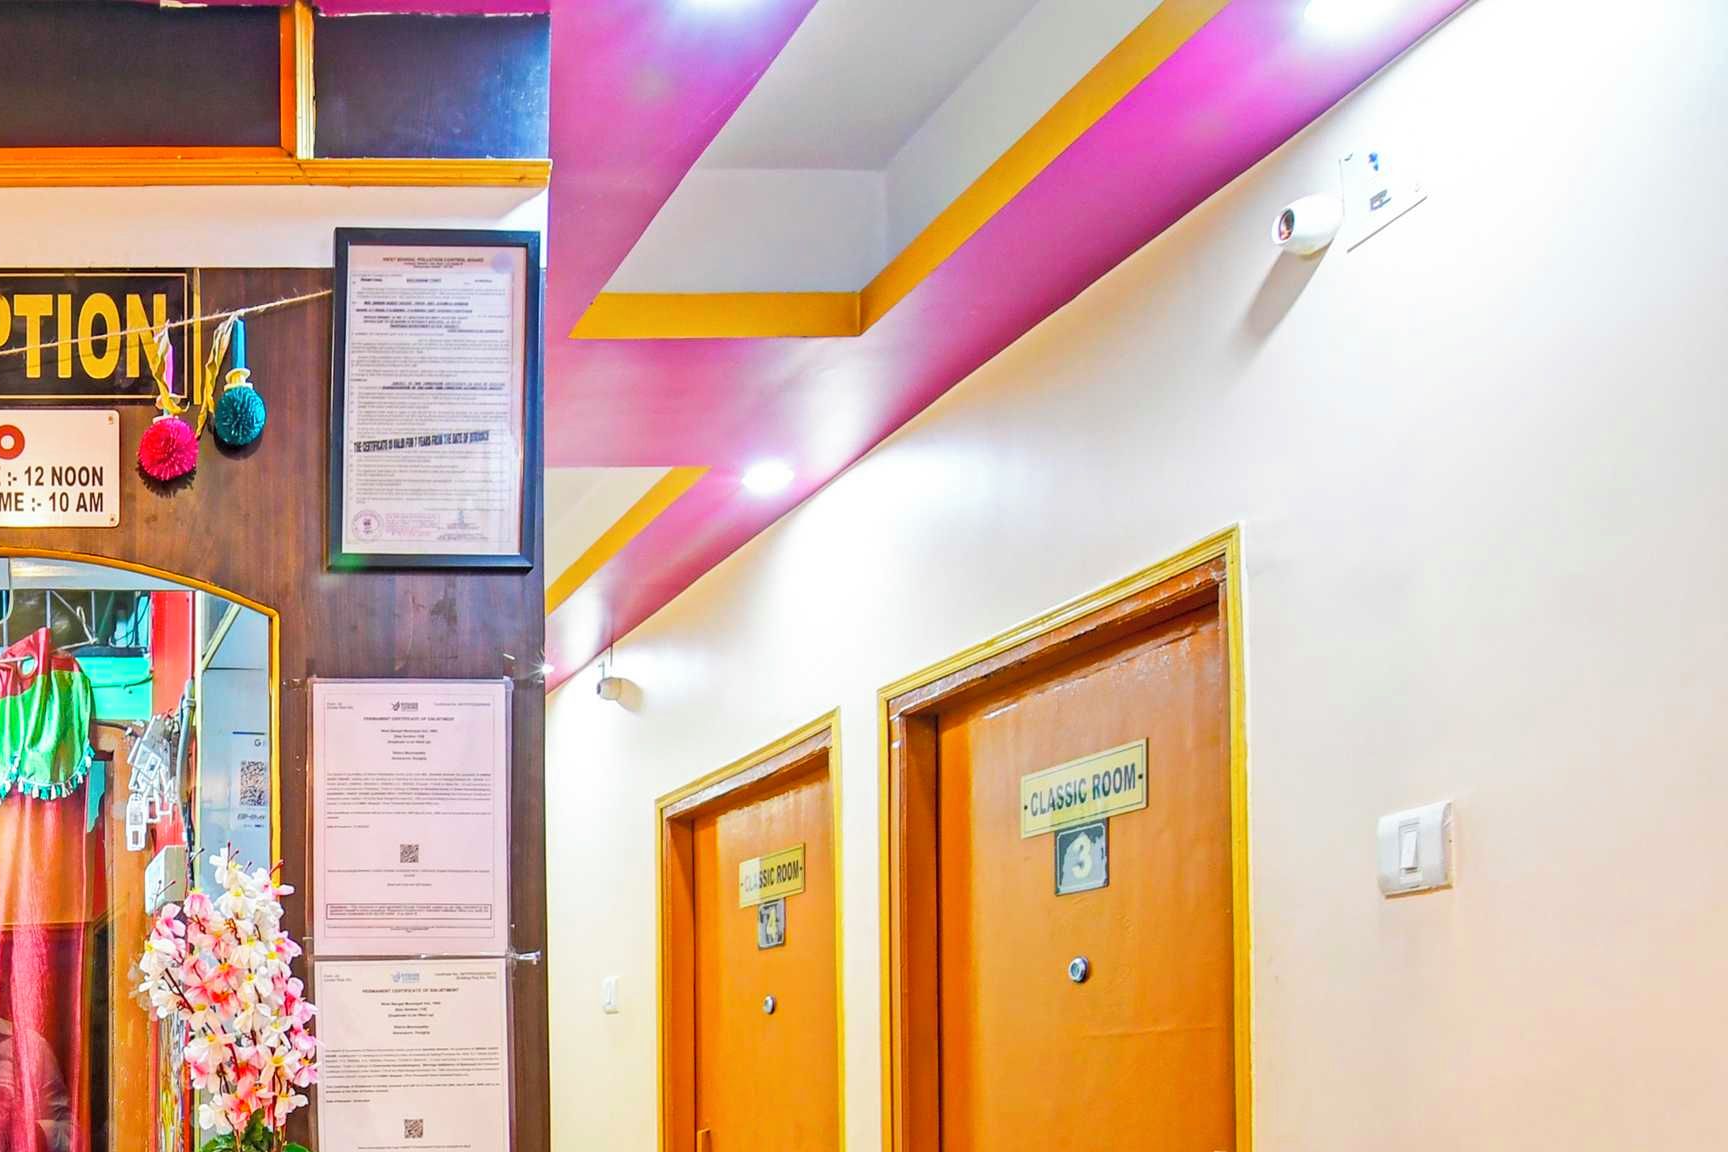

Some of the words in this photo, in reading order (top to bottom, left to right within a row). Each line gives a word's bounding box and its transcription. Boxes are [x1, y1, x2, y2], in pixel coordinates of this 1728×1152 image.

[24, 466, 45, 487] 12
[51, 466, 105, 487] NOON
[48, 491, 70, 513] 10
[76, 491, 105, 513] AM
[1030, 778, 1088, 817] CLASSIC
[1092, 762, 1136, 800] ROOM
[1072, 831, 1093, 880] 3
[776, 860, 799, 884] ROOM
